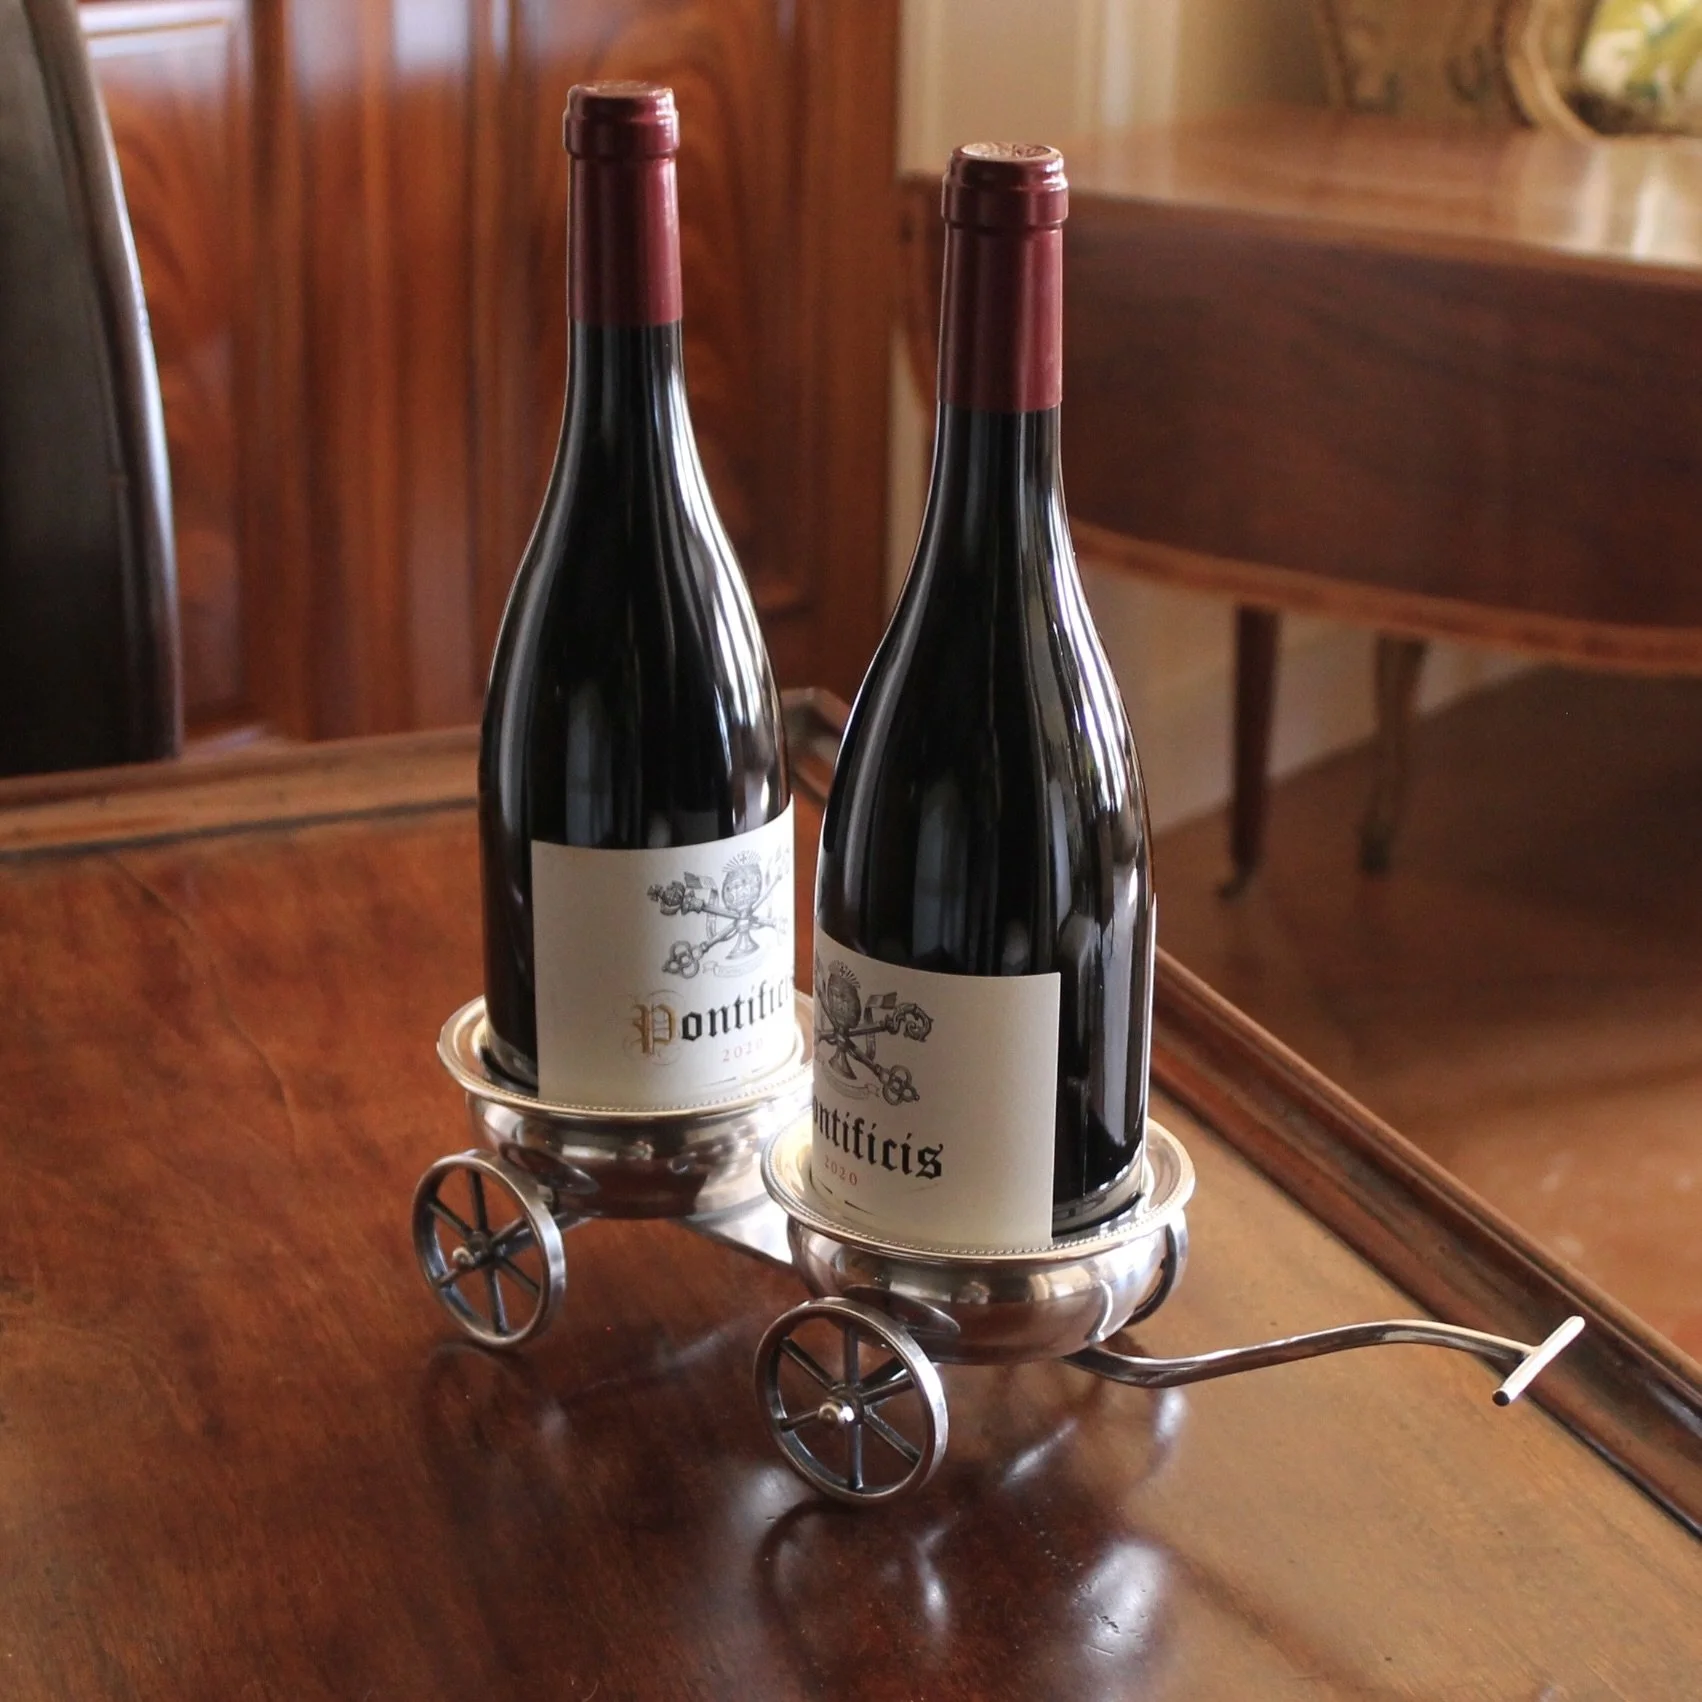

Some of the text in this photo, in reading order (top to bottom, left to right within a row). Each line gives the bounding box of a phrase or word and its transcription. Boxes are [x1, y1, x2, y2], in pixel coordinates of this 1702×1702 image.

[631, 976, 795, 1056] Pontifici
[812, 1095, 944, 1181] ontificis
[823, 1153, 859, 1187] 2020
